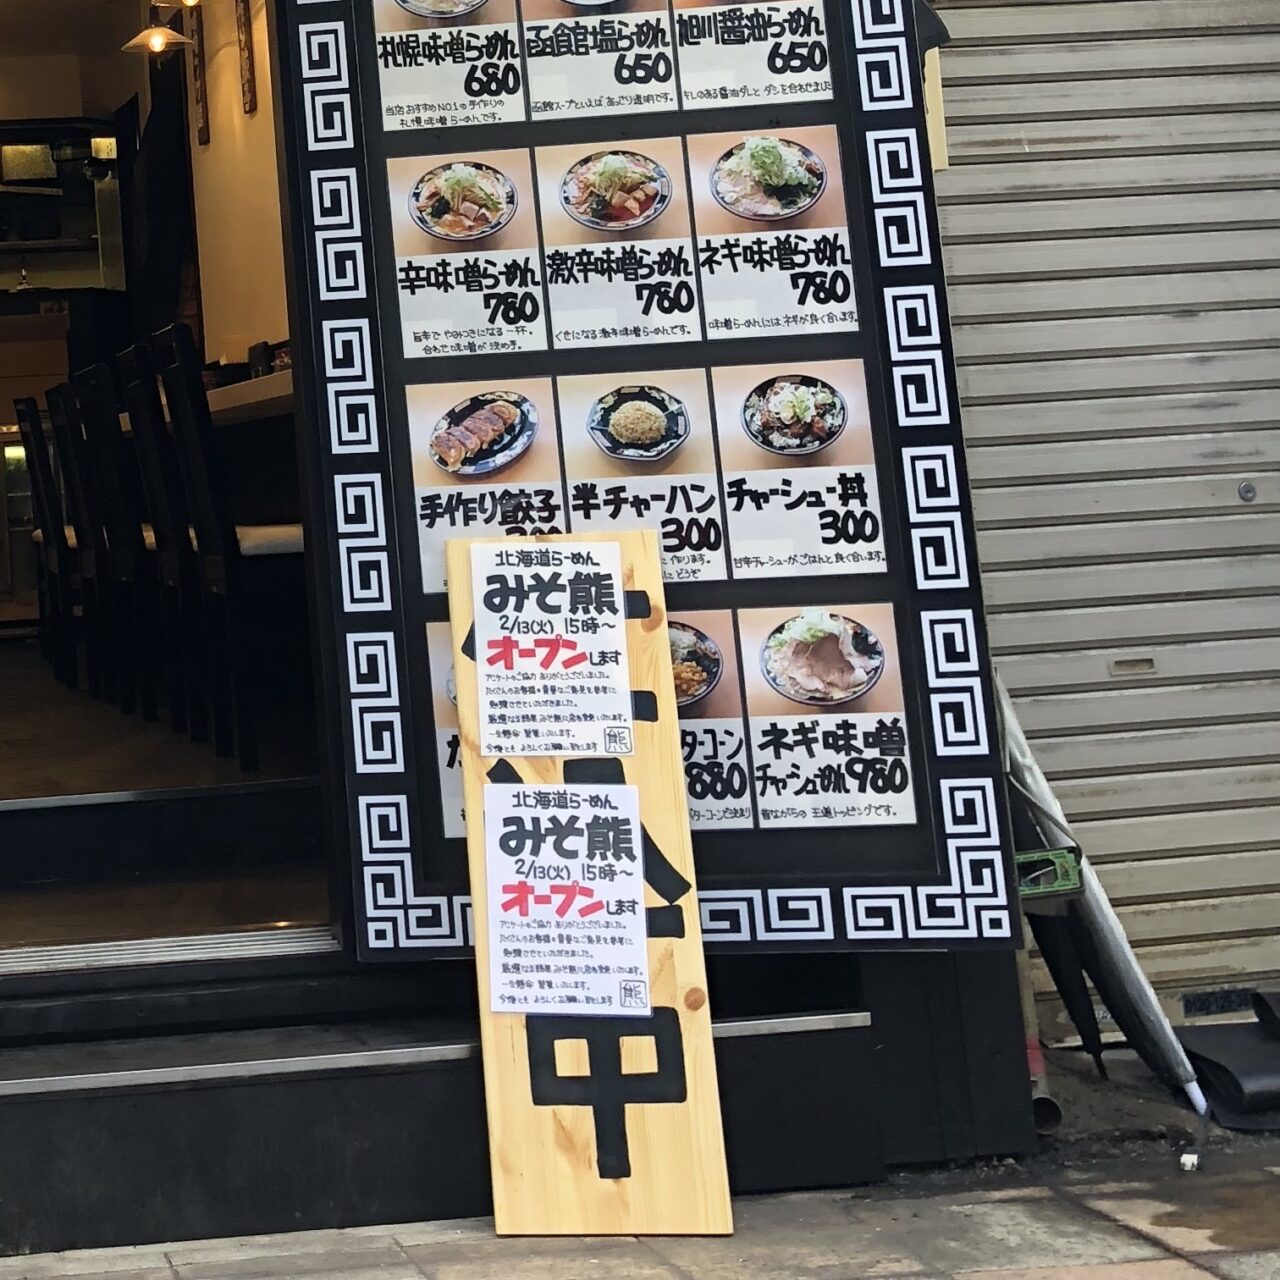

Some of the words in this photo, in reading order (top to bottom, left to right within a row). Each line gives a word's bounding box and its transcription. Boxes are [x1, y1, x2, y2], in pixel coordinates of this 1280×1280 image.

[378, 29, 520, 69] 札幌味噌らーめん
[526, 18, 671, 58] 函館塩らーめん
[614, 52, 673, 85] 650
[767, 40, 828, 74] 650
[464, 63, 521, 98] 680
[635, 280, 695, 316] 780
[790, 270, 851, 305] 780
[420, 489, 561, 529] 手作り餃子
[572, 483, 716, 520] 半チャーハン
[727, 472, 868, 512] チャーシュー丼
[660, 517, 722, 553] 300
[818, 509, 880, 545] 300
[495, 548, 600, 567] 北海道らーめん
[483, 571, 619, 616] みそ熊
[757, 717, 906, 760] ネギ味噌
[685, 761, 748, 800] 880
[845, 757, 909, 794] 980
[512, 790, 619, 810] 北海道らーめん
[499, 814, 637, 863] みそ熊
